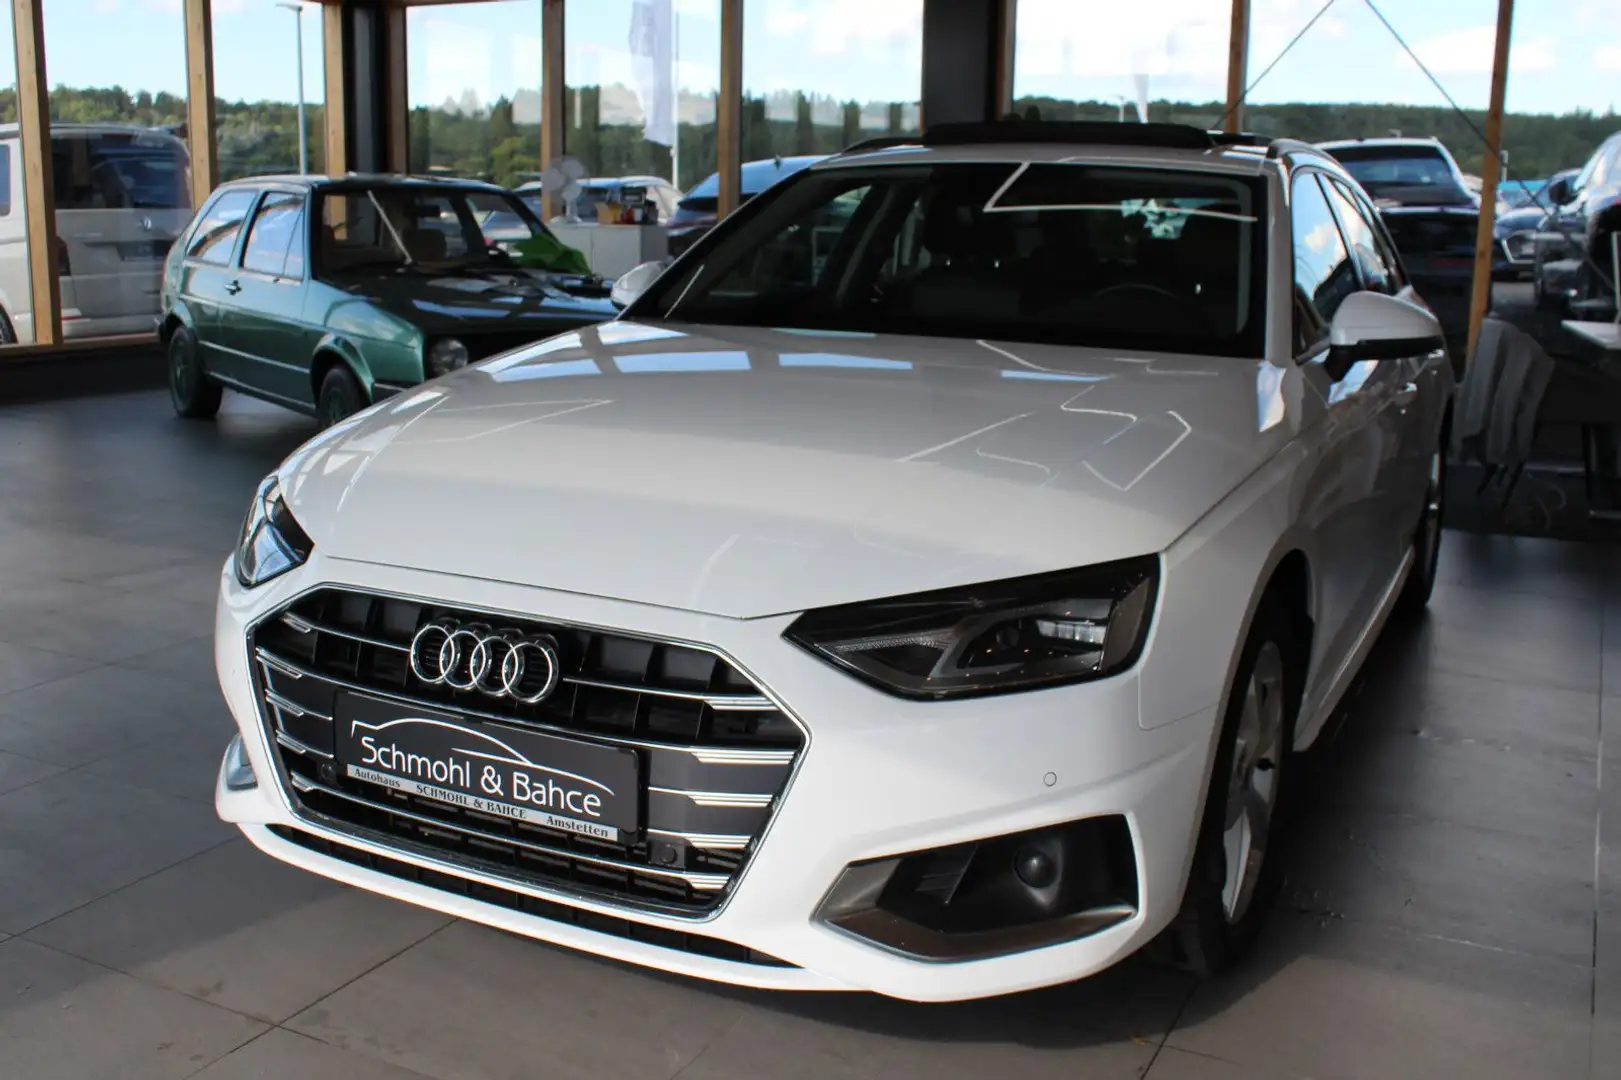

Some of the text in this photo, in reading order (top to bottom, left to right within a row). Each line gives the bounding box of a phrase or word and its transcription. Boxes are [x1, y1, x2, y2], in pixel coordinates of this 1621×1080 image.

[353, 768, 609, 838] Autohaus SCHMOHL & BAHCE Amstetten
[361, 736, 602, 817] Schmohl & Bahce
